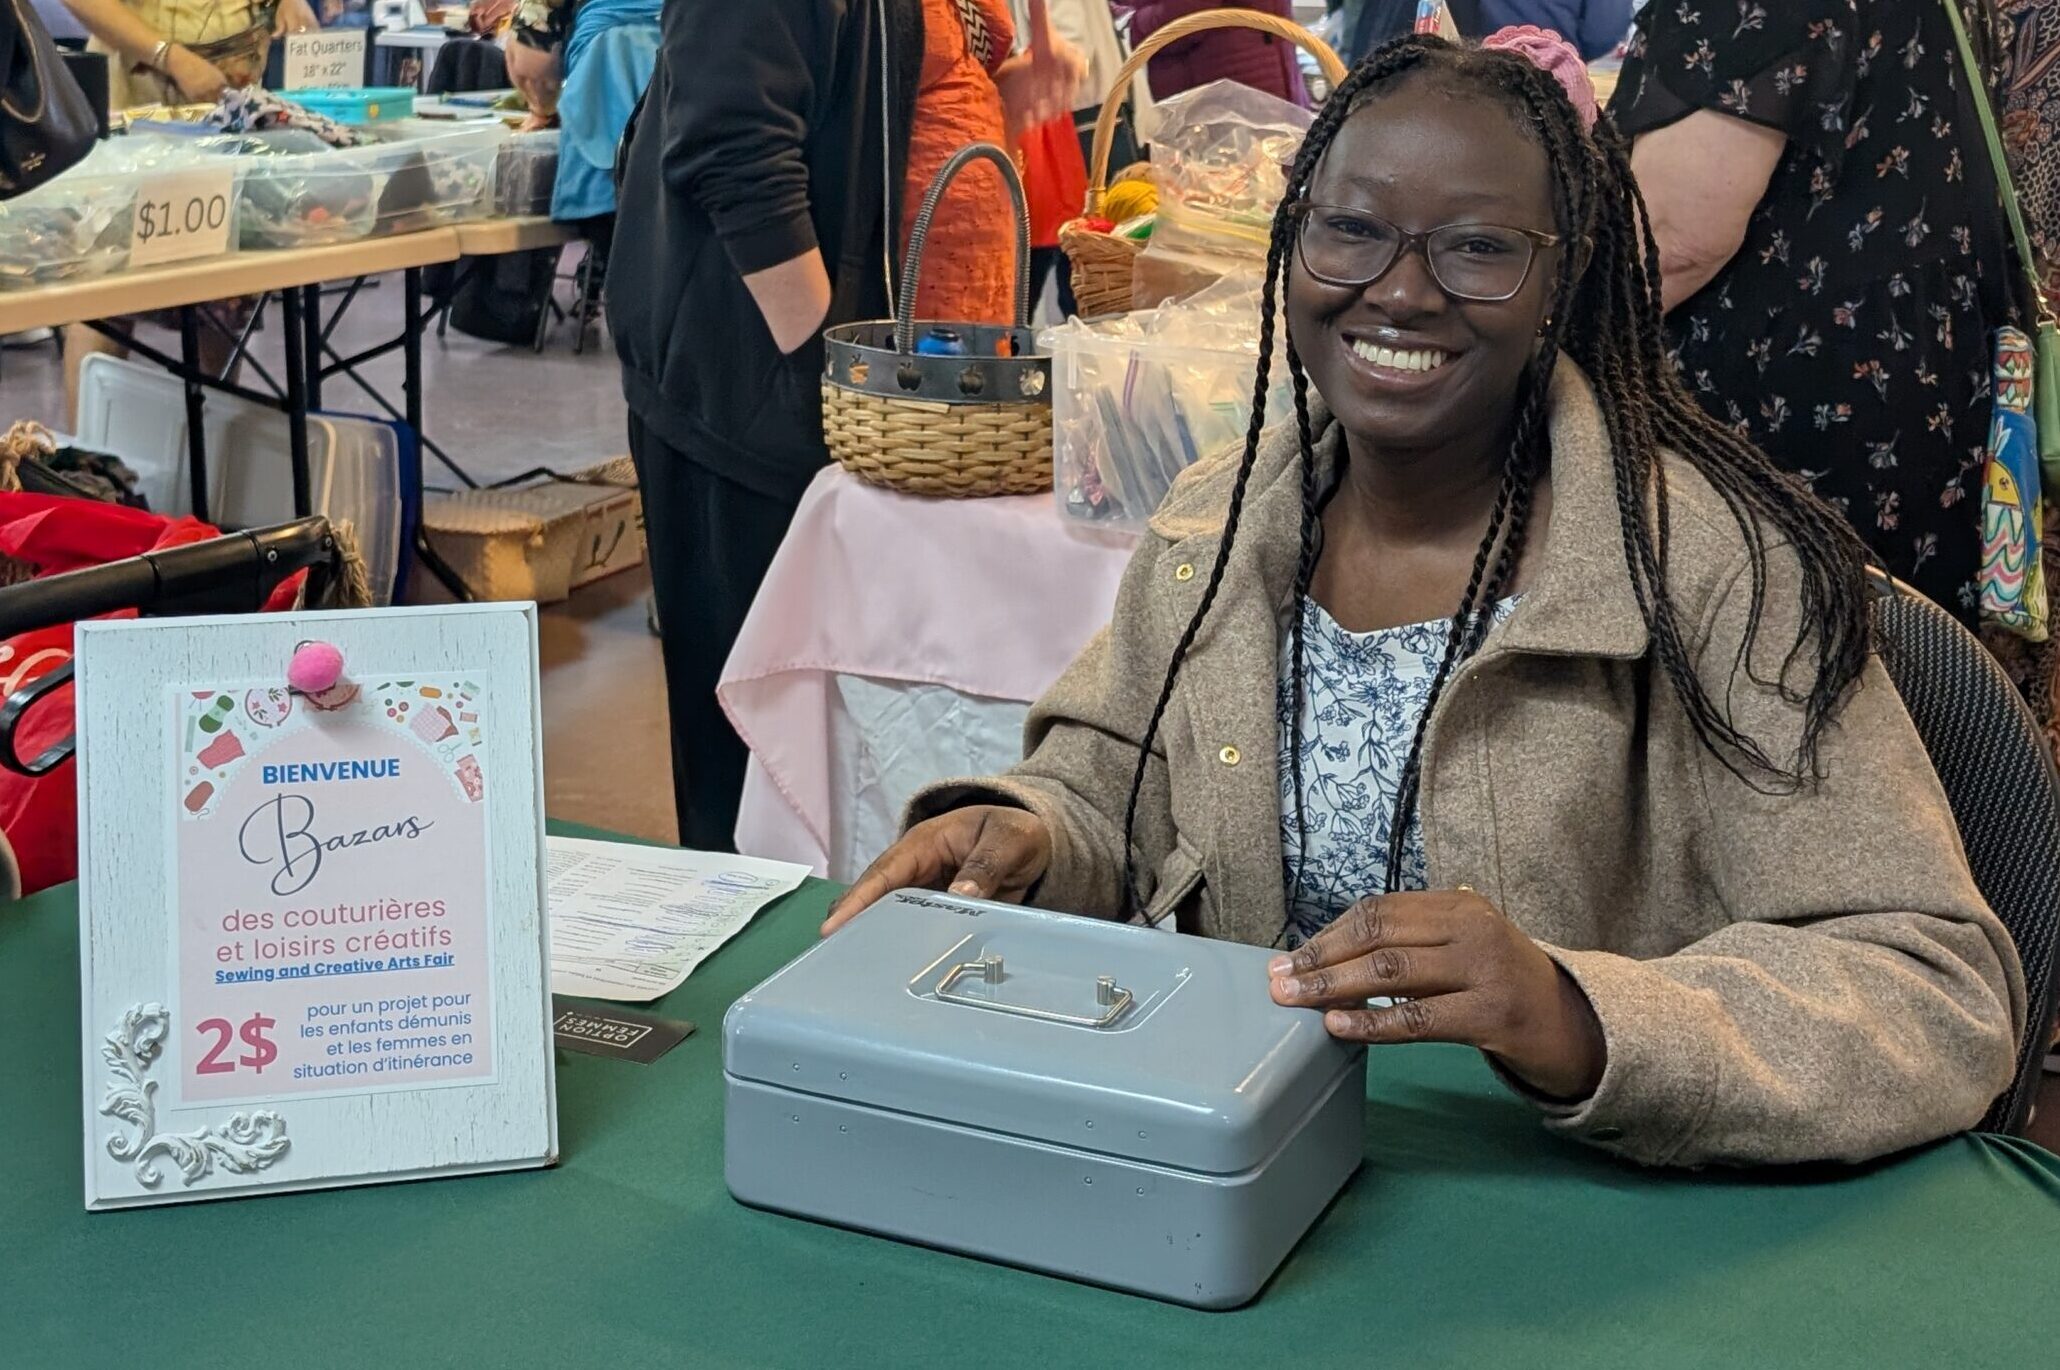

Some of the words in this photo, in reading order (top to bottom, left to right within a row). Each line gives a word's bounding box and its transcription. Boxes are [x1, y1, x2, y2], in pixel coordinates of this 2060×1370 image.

[290, 41, 308, 56] Fat
[311, 40, 363, 57] Quarters
[137, 194, 226, 245] $1.00
[263, 758, 401, 785] BIENVENUE
[239, 793, 434, 896] Bazars
[222, 909, 274, 932] des
[283, 898, 446, 928] couturières
[216, 941, 244, 962] et
[255, 935, 335, 960] loisirs
[346, 925, 452, 953] créatifs
[215, 967, 274, 984] Sewing
[279, 963, 310, 980] and
[314, 956, 384, 975] Creative
[387, 956, 420, 970] Arts
[425, 952, 455, 967] Fair
[307, 1002, 347, 1021] pour
[352, 1001, 374, 1014] un
[379, 995, 428, 1017] projet
[433, 993, 471, 1011] pour
[300, 1024, 324, 1038] les
[329, 1019, 393, 1036] enfants
[398, 1011, 472, 1030] démunis
[559, 1023, 628, 1042] OPTION
[566, 1017, 640, 1037] FEMMES
[196, 1012, 278, 1075] 2$
[327, 1042, 344, 1056] et
[348, 1039, 372, 1054] les
[376, 1034, 446, 1052] femmes
[451, 1032, 472, 1045] en
[293, 1061, 368, 1080] situation
